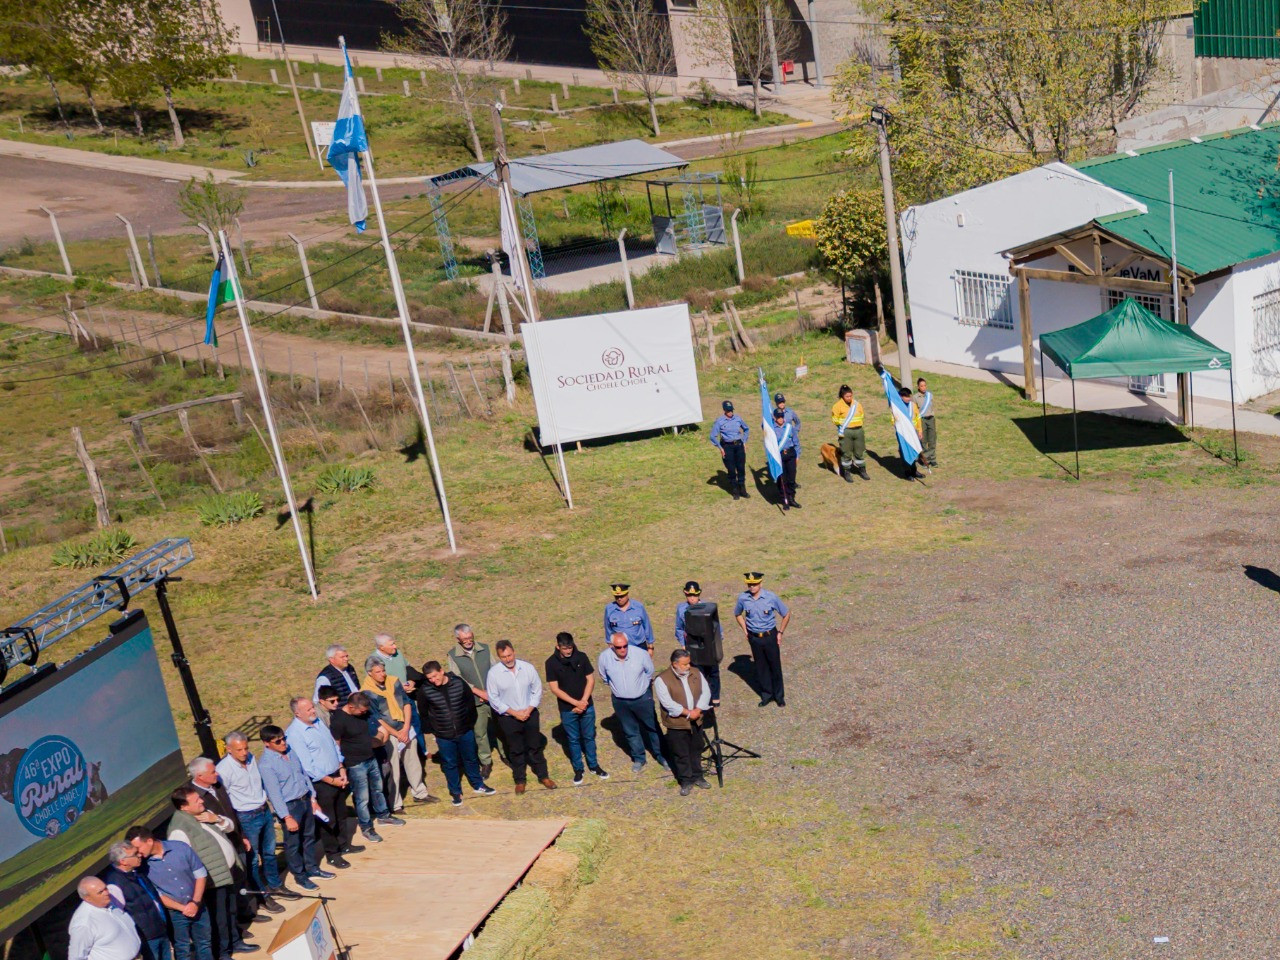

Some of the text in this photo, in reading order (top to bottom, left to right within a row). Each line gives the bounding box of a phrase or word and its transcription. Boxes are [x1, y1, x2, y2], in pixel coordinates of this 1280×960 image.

[557, 363, 673, 389] SOCIEDAD RURAL
[586, 377, 649, 392] CHOELE CHOEL
[40, 746, 71, 779] EXPO
[20, 754, 83, 818] Rural
[34, 787, 81, 825] CHOELE CHOEL
